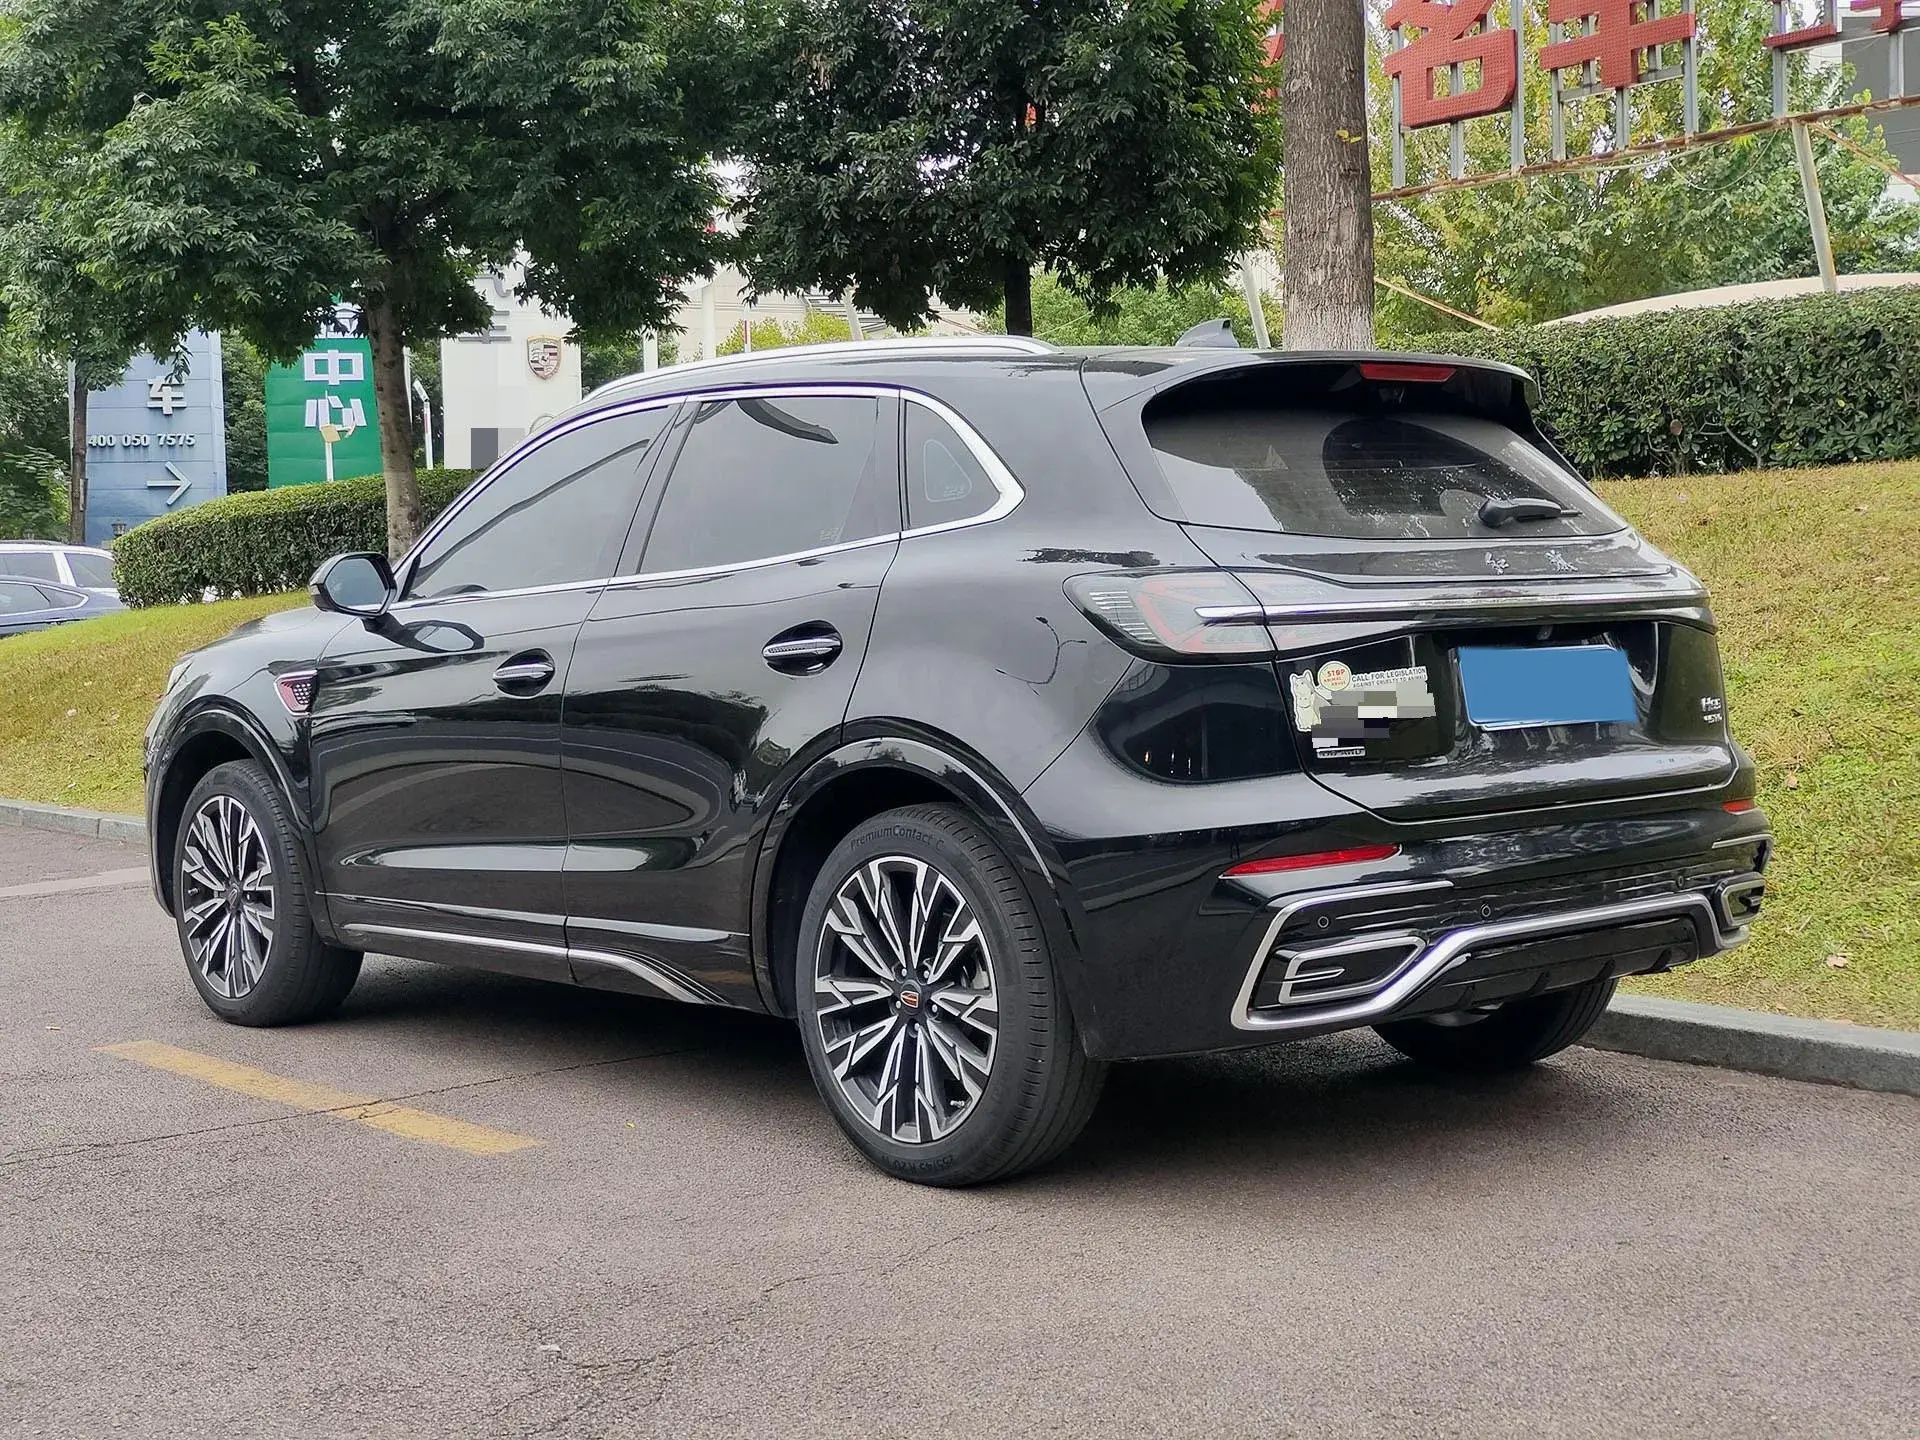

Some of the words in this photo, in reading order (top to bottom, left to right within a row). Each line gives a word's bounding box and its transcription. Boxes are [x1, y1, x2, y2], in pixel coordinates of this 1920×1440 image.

[147, 375, 187, 415] 车
[88, 434, 116, 447] 400
[121, 434, 150, 447] 050
[157, 433, 196, 446] 7575
[1327, 669, 1346, 677] STOP
[1352, 674, 1369, 682] CALL
[1387, 668, 1426, 678] LEGISLATION
